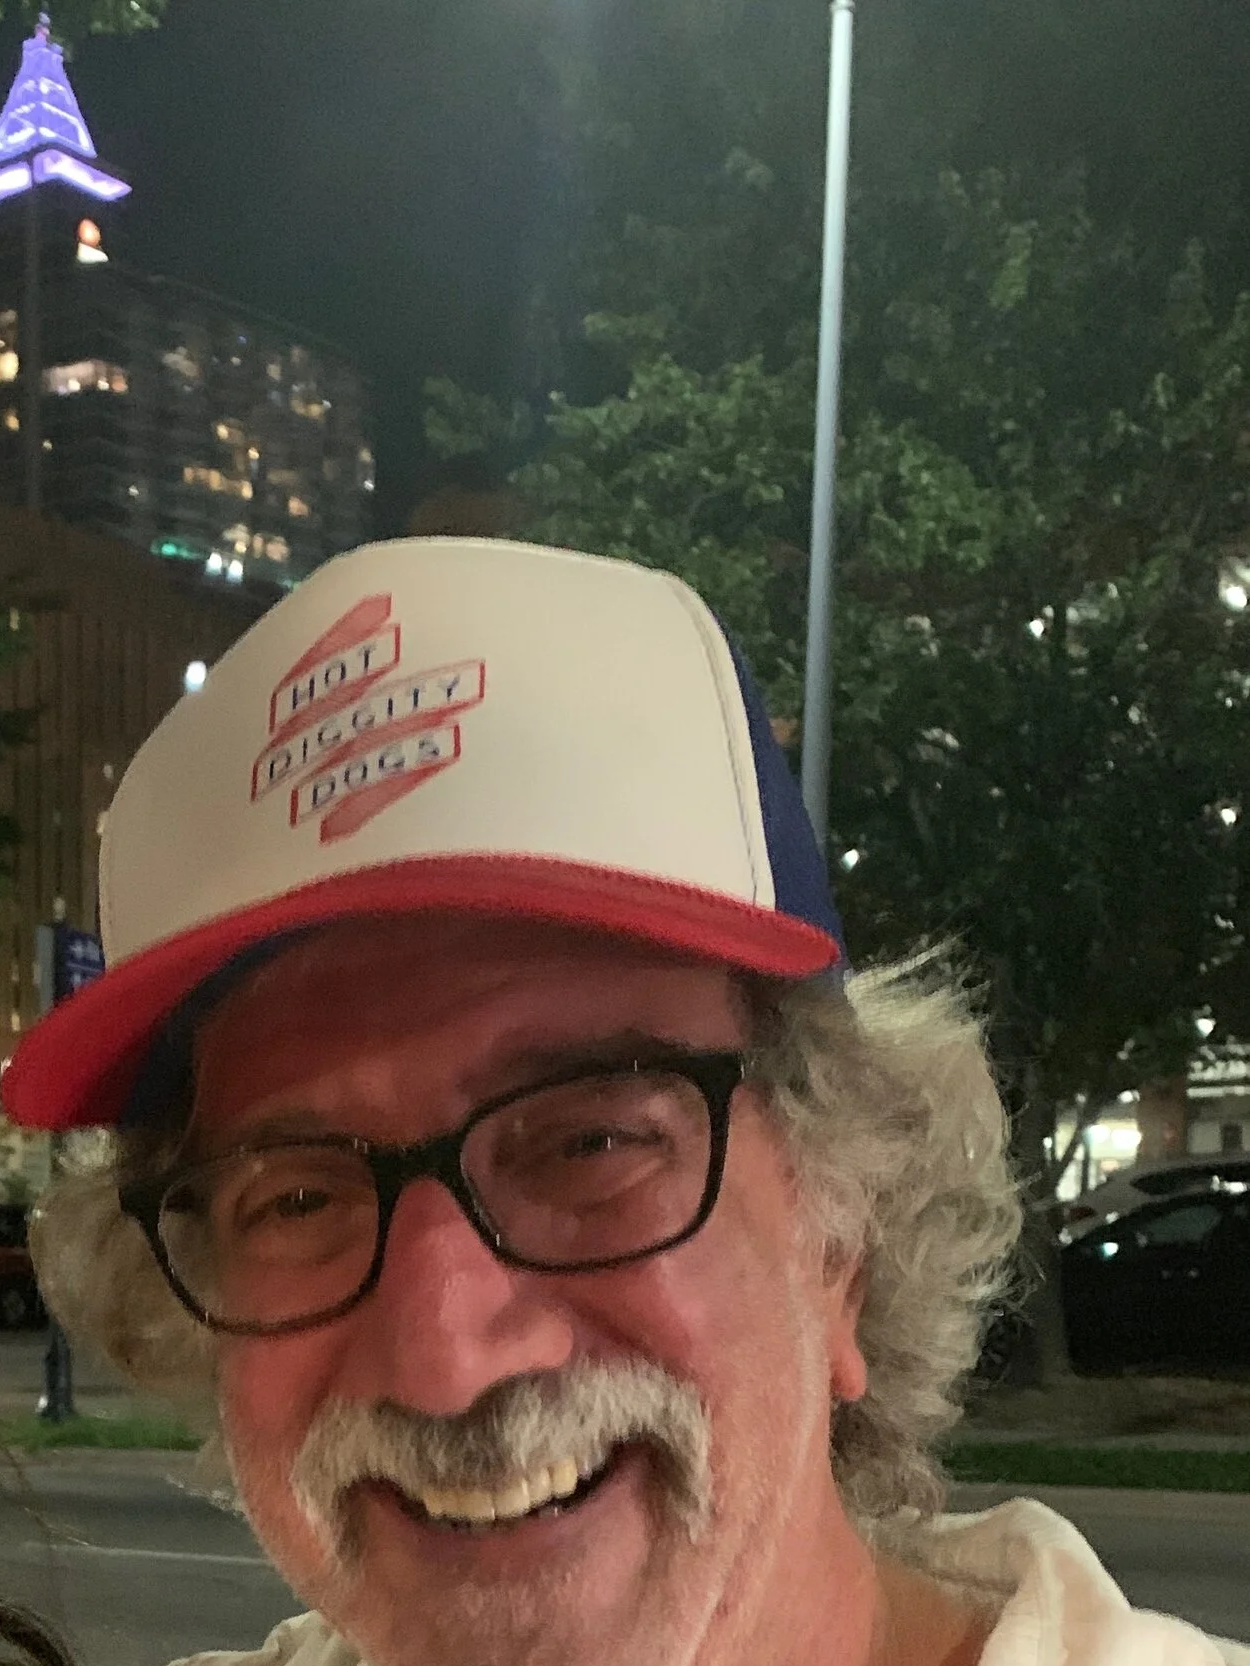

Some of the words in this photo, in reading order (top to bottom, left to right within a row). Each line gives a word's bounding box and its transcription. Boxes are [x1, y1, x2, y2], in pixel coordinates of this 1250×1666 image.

[291, 643, 376, 711] HOT
[268, 676, 461, 780] DIGGITY
[312, 735, 441, 809] DOGS
